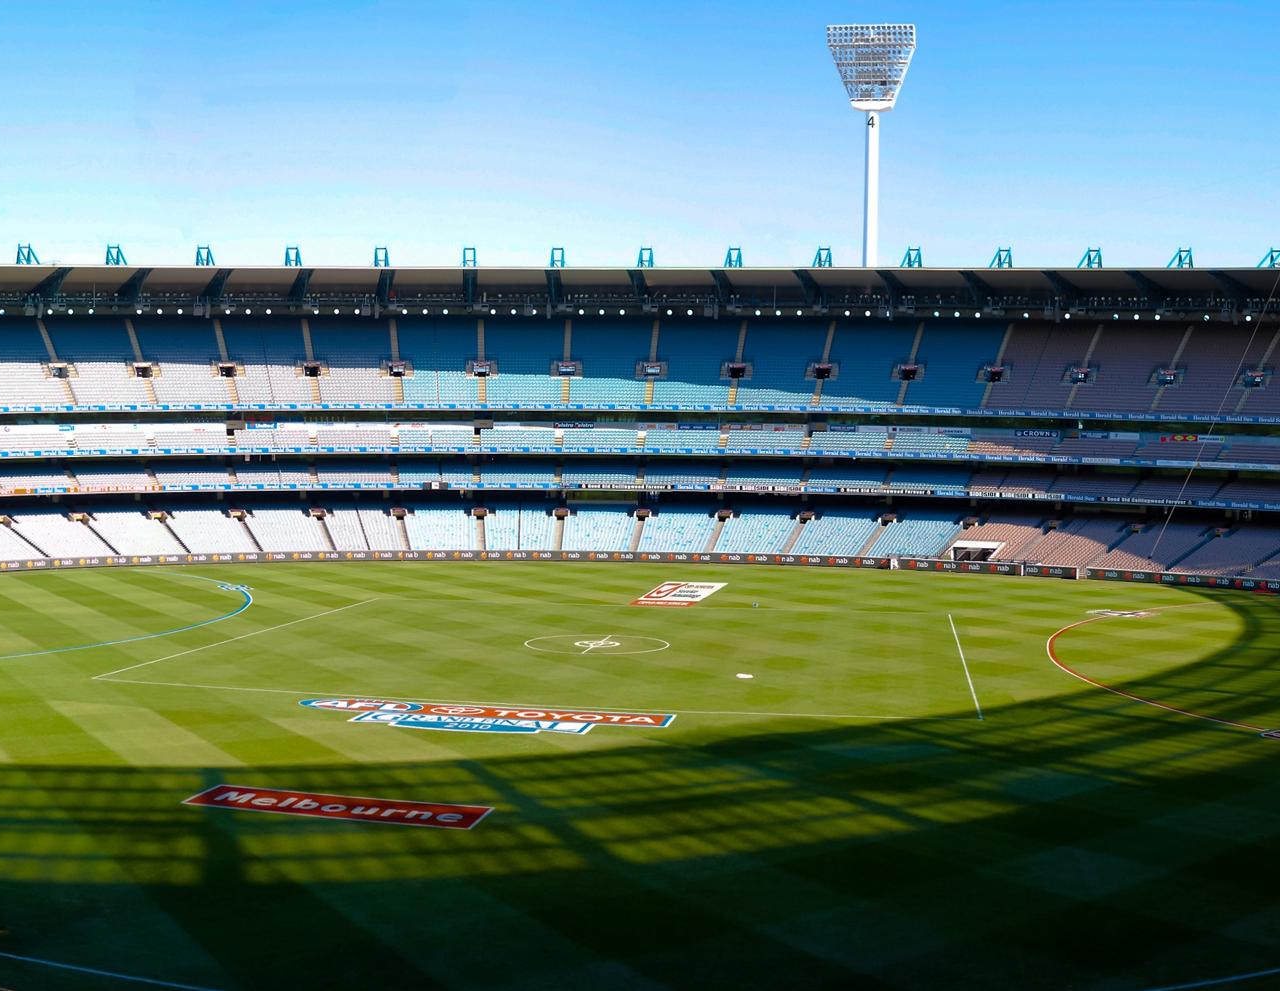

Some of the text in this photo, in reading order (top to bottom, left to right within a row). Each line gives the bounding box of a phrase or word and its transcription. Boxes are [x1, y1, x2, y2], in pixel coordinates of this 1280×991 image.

[867, 116, 875, 128] 4
[310, 700, 411, 711] AFL
[495, 709, 655, 723] TOYOTA
[444, 722, 491, 730] 2010
[213, 791, 464, 823] Melbourne
